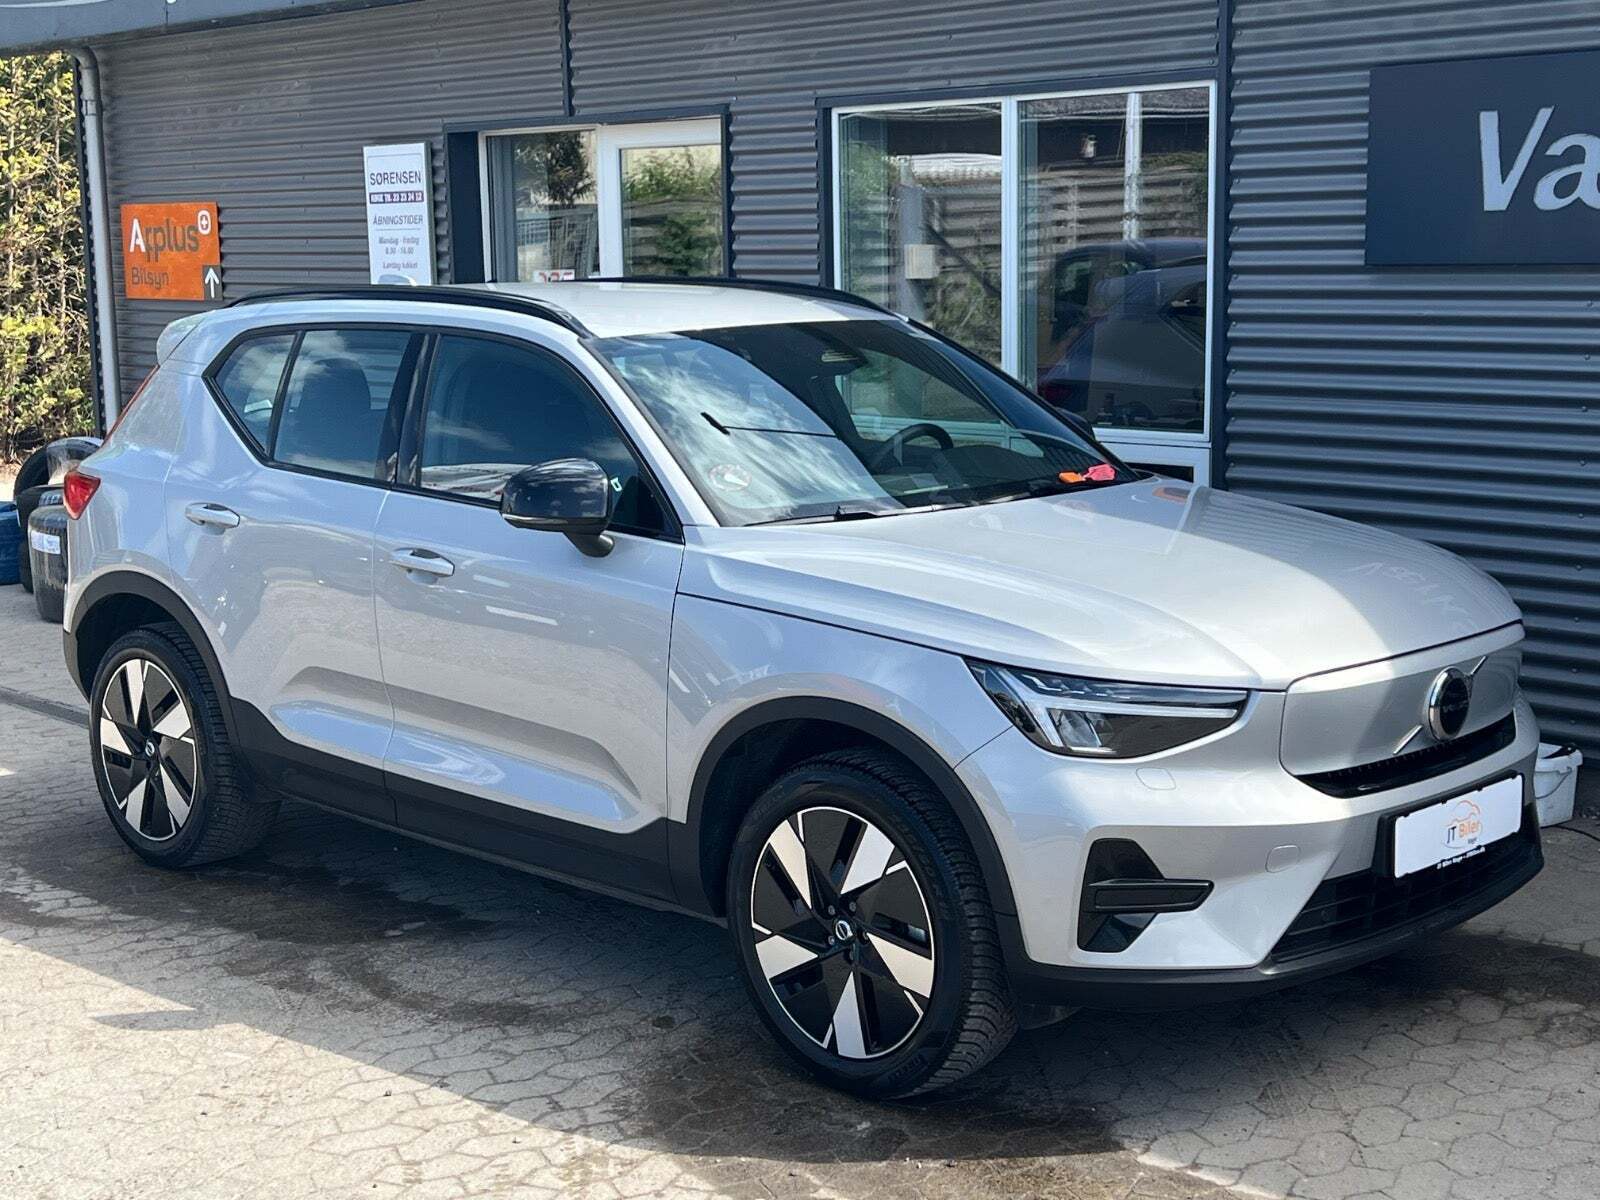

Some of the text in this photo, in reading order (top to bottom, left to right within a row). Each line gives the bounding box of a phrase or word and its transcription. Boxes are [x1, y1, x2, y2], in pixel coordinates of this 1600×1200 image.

[1479, 105, 1600, 211] Va
[373, 214, 424, 225] ÅBNINGSTIDER
[131, 267, 169, 289] Bilsyn
